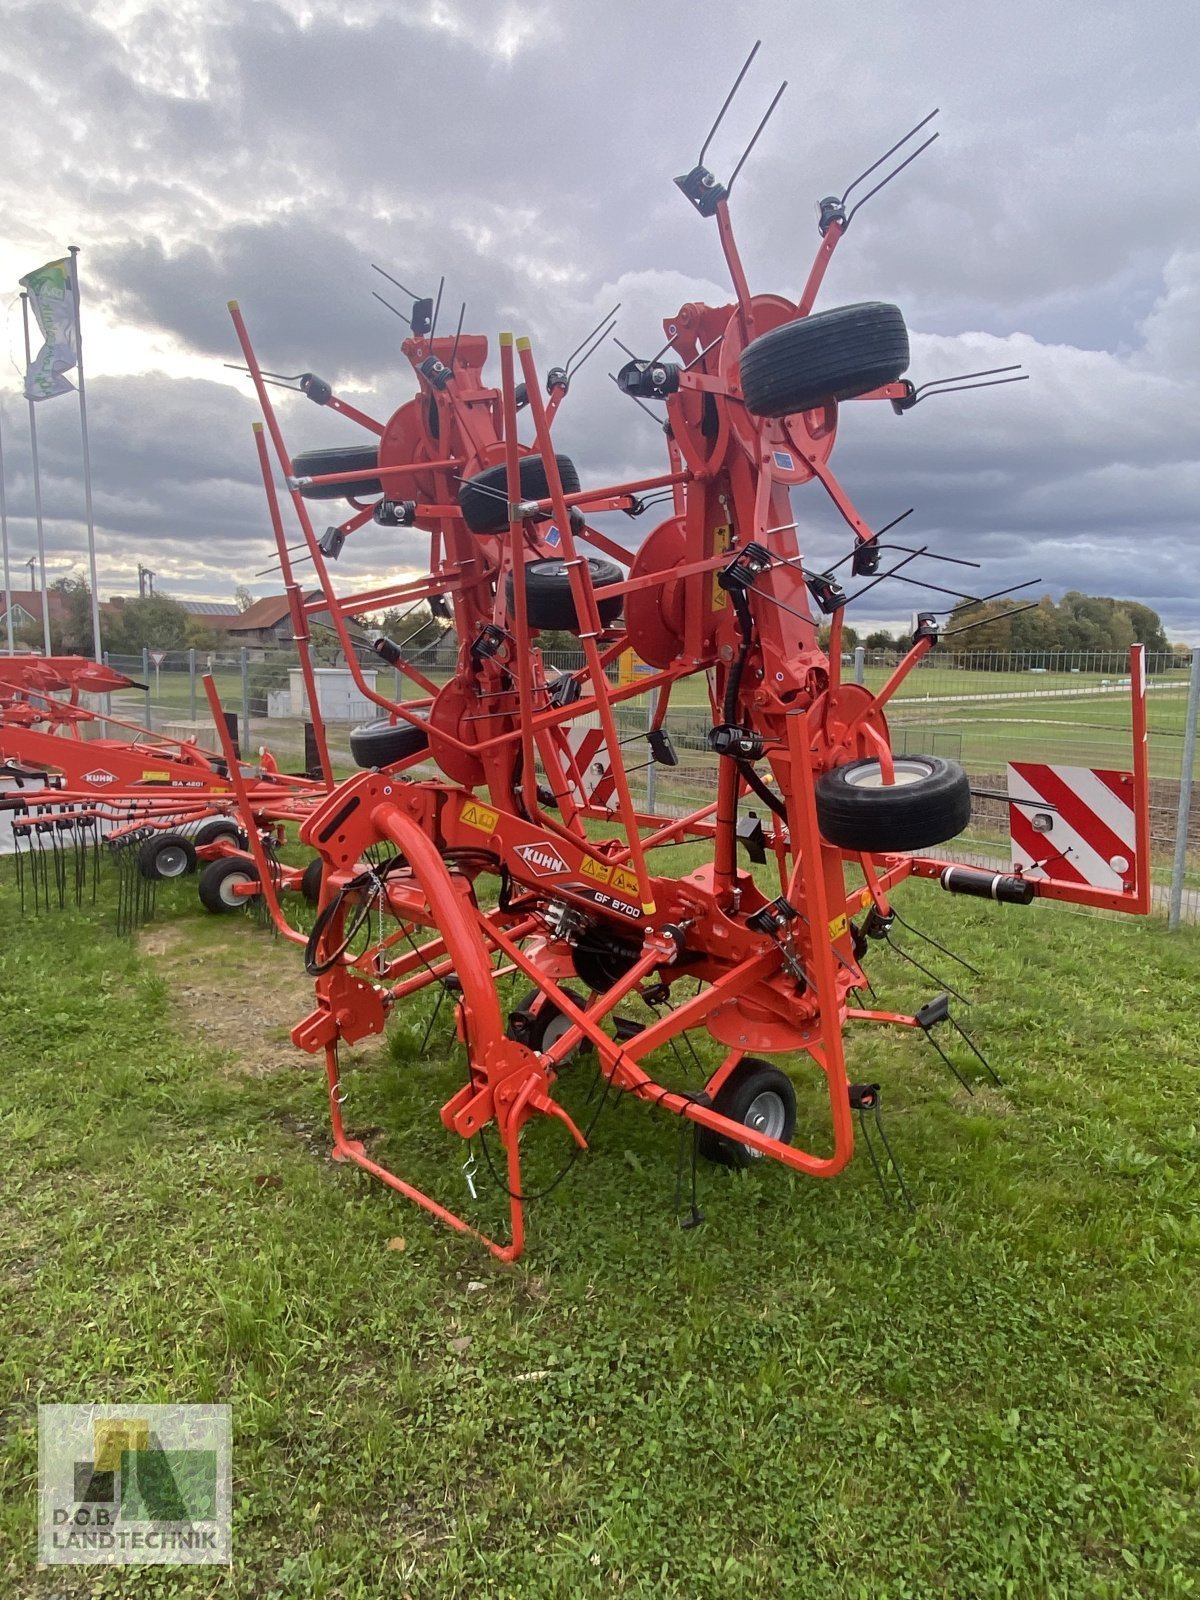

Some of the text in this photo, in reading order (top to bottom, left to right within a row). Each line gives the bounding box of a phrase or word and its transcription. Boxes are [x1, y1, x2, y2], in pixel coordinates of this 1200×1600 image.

[86, 774, 113, 782] KUHN
[522, 847, 563, 872] KUHN
[594, 891, 641, 918] GF 8700
